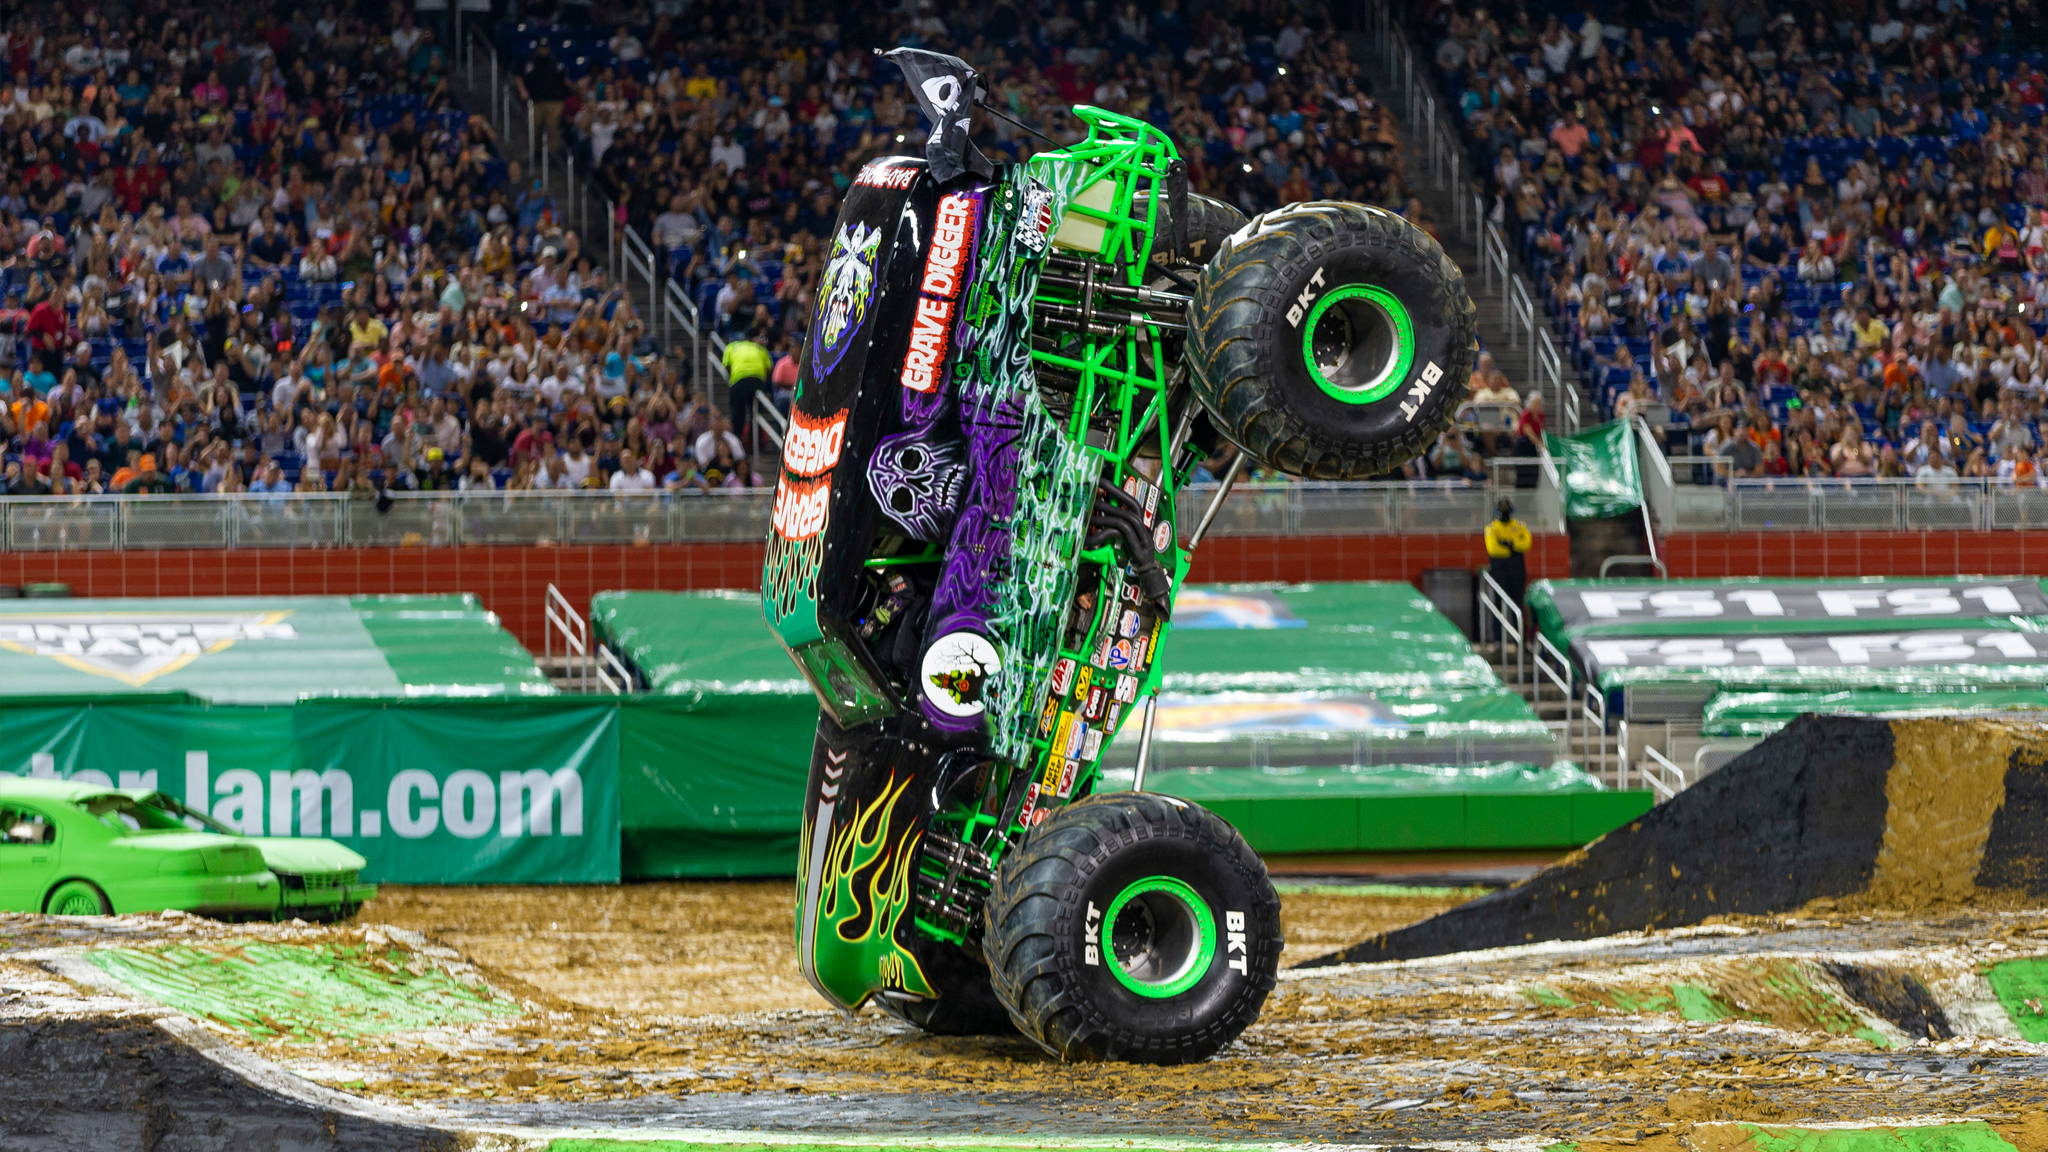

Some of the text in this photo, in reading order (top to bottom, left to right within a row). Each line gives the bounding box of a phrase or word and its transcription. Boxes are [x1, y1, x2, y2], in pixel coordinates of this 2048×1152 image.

[886, 166, 918, 189] BAD
[903, 196, 970, 391] GRAVE DIGGER
[1286, 267, 1325, 328] BKT
[1399, 361, 1443, 422] BKT
[784, 415, 844, 473] DIGGER
[773, 476, 829, 537] GRAVE
[1147, 486, 1157, 510] KING
[1580, 586, 2022, 618] FS1 FS1
[36, 637, 201, 656] JAM
[1111, 648, 1128, 665] VP
[1587, 632, 2037, 665] FS1 FS1
[1053, 660, 1067, 690] JAZ
[1087, 689, 1101, 717] Coan
[1020, 784, 1036, 826] ARP
[1085, 901, 1101, 966] BKT
[1226, 911, 1247, 976] BKT
